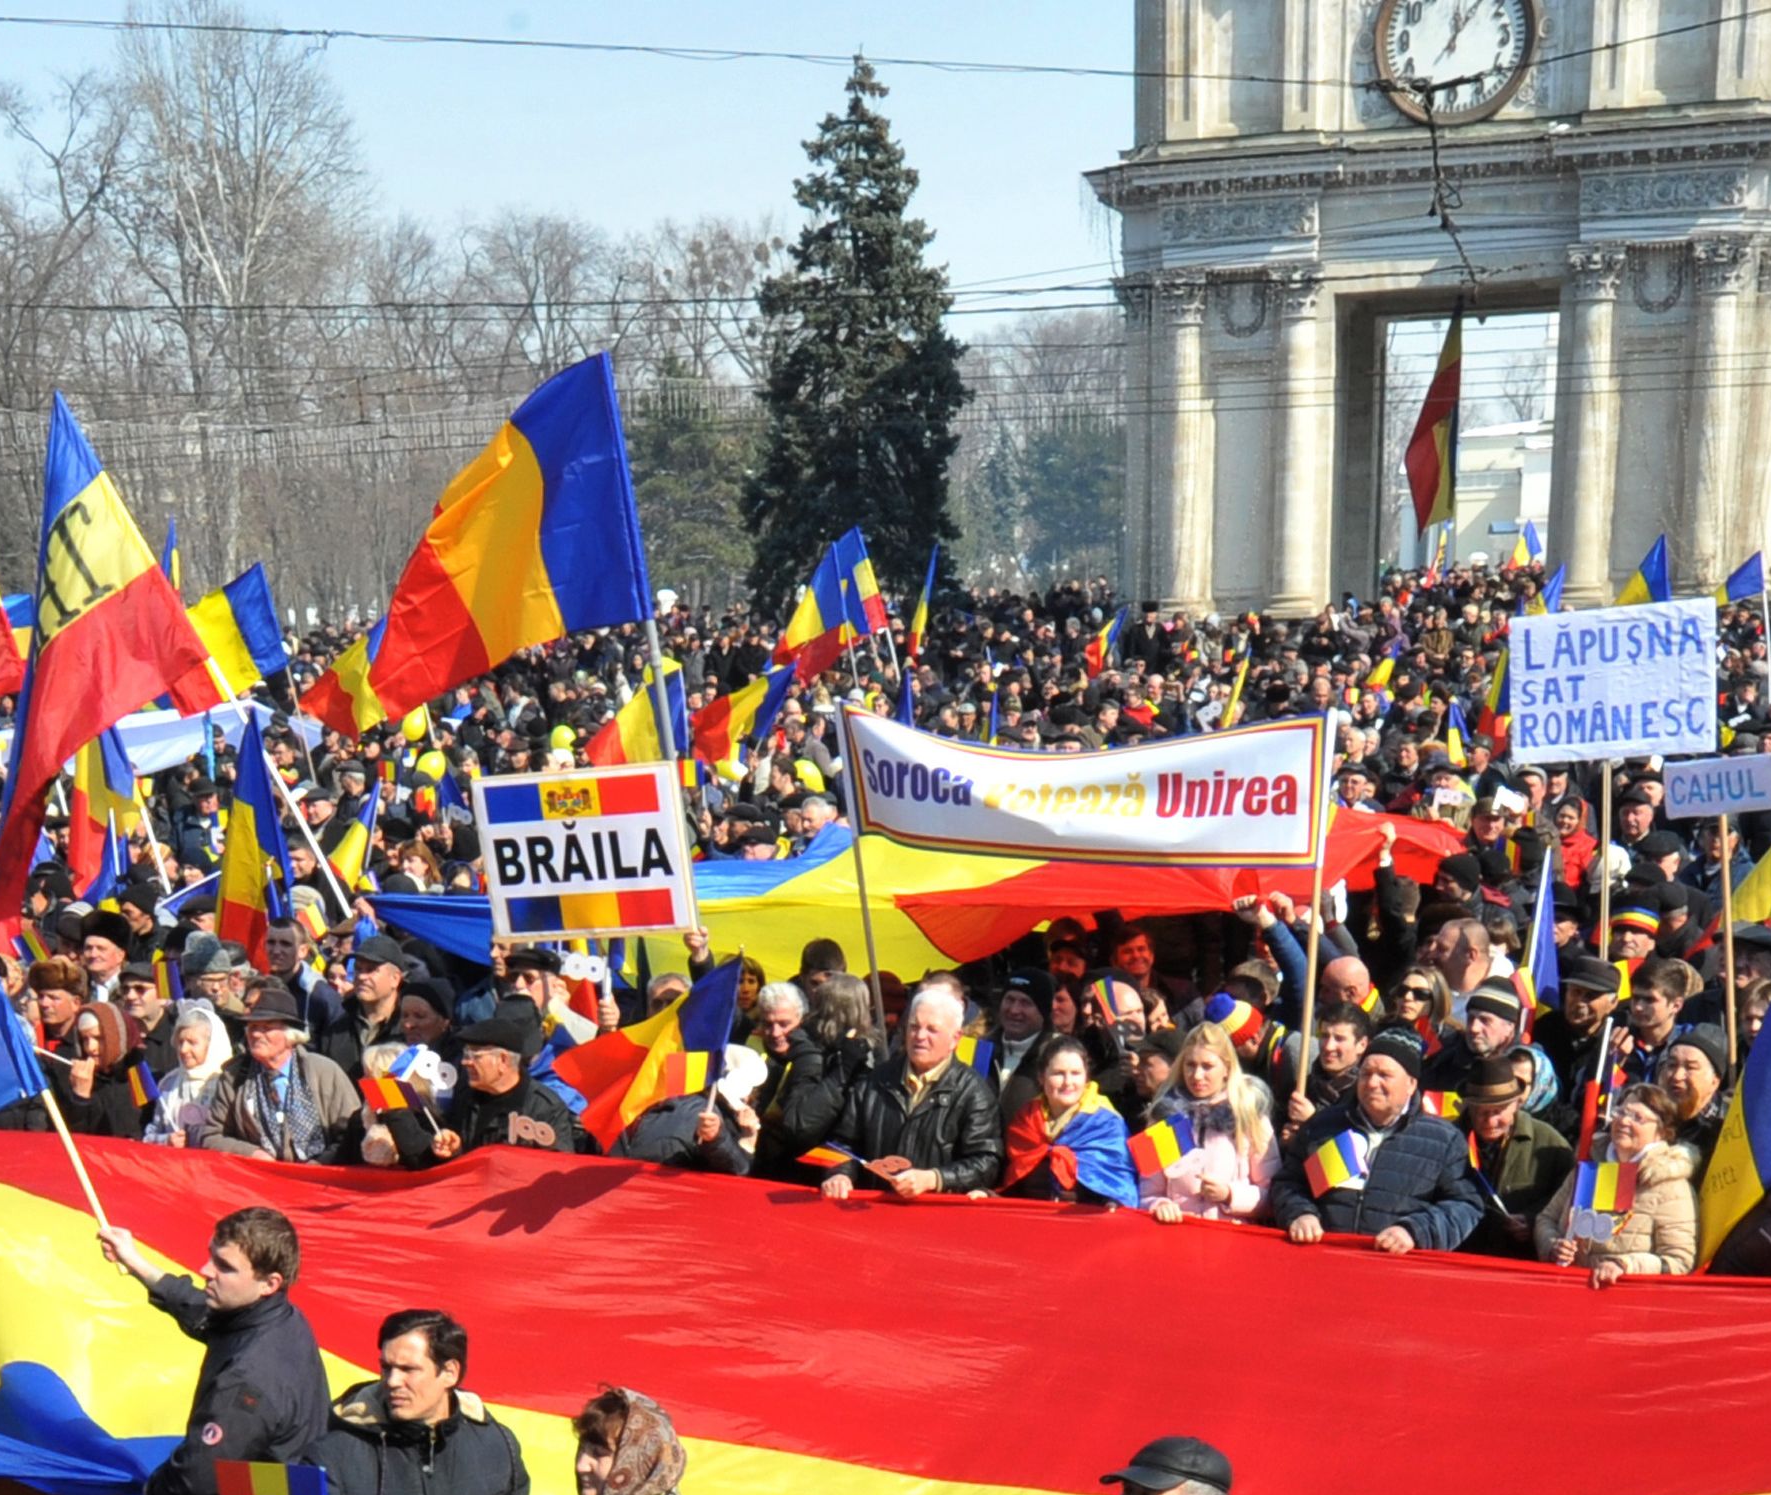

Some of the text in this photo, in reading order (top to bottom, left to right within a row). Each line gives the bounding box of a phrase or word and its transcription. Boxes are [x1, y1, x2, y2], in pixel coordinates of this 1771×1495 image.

[1521, 675, 1586, 706] SAT
[862, 747, 974, 807] Soroca
[1154, 769, 1298, 819] Unirea
[1670, 767, 1766, 806] CAHUL
[493, 820, 674, 886] BRĂILA
